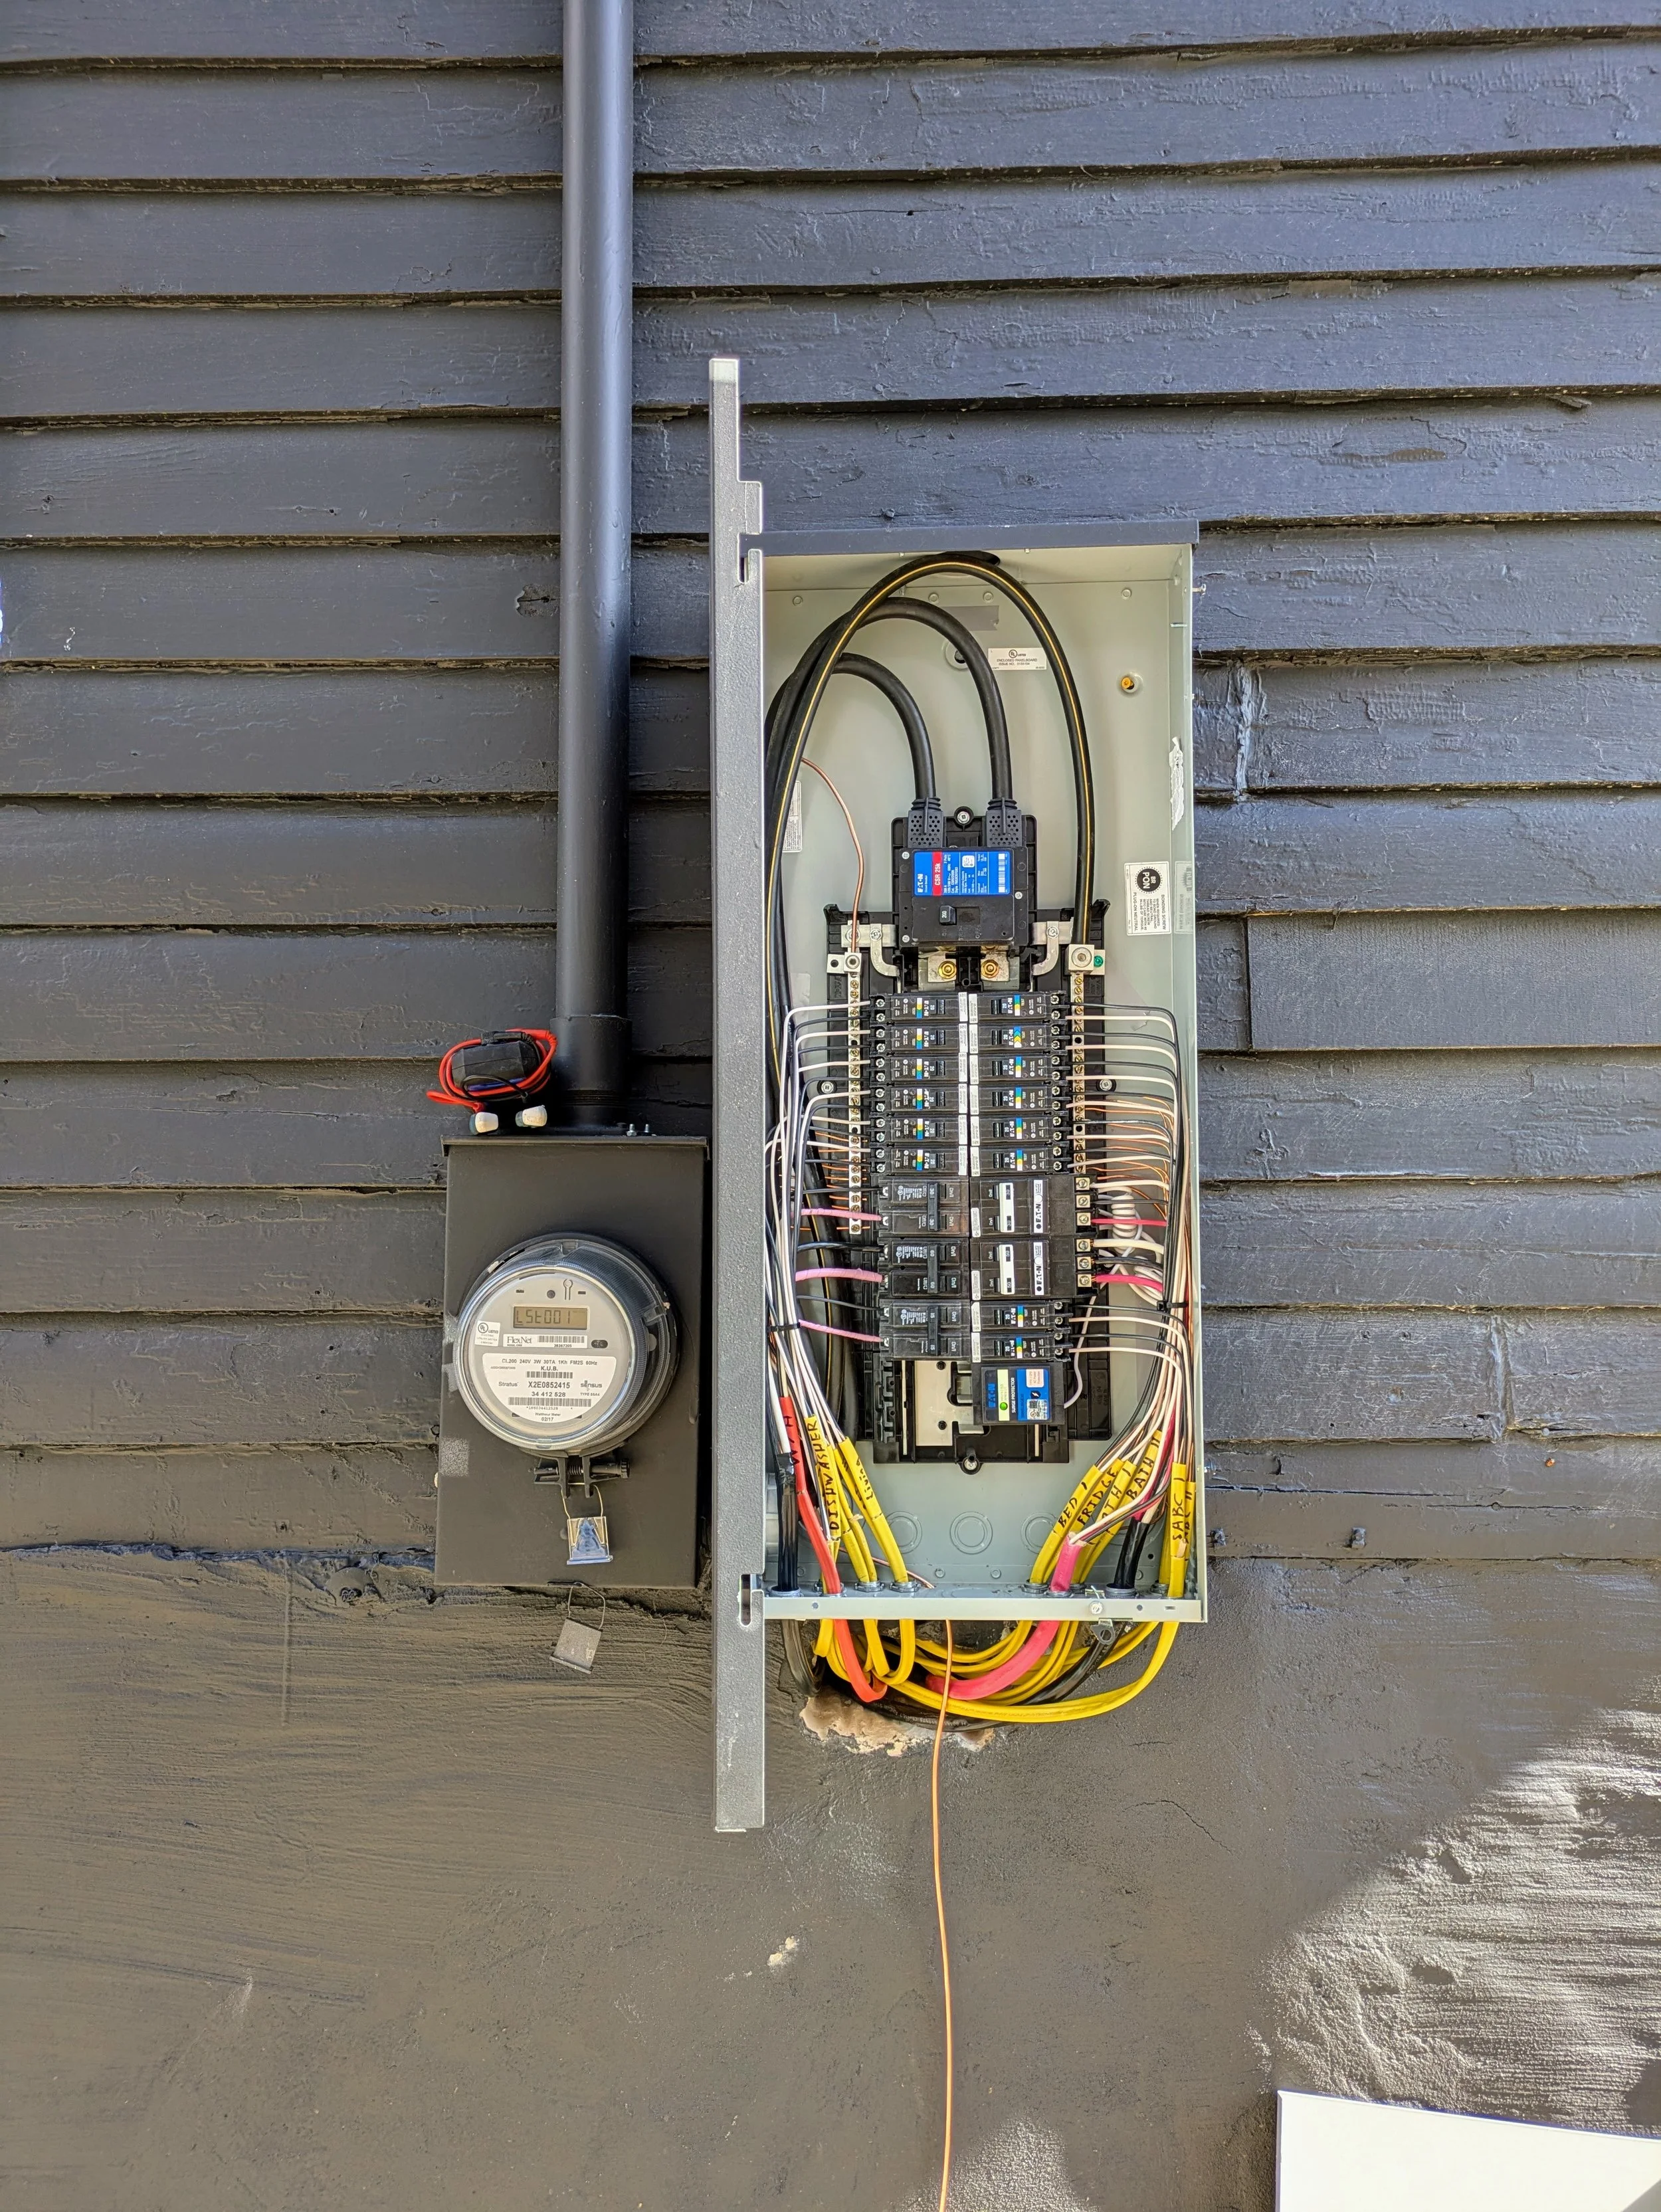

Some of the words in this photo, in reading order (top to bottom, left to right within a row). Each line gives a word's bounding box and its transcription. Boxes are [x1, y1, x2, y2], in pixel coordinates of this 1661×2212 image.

[807, 1420, 840, 1530] DISHWASHER
[1077, 1467, 1118, 1526] FRIDGE
[1125, 1457, 1154, 1501] BATH
[1058, 1497, 1078, 1528] BED
